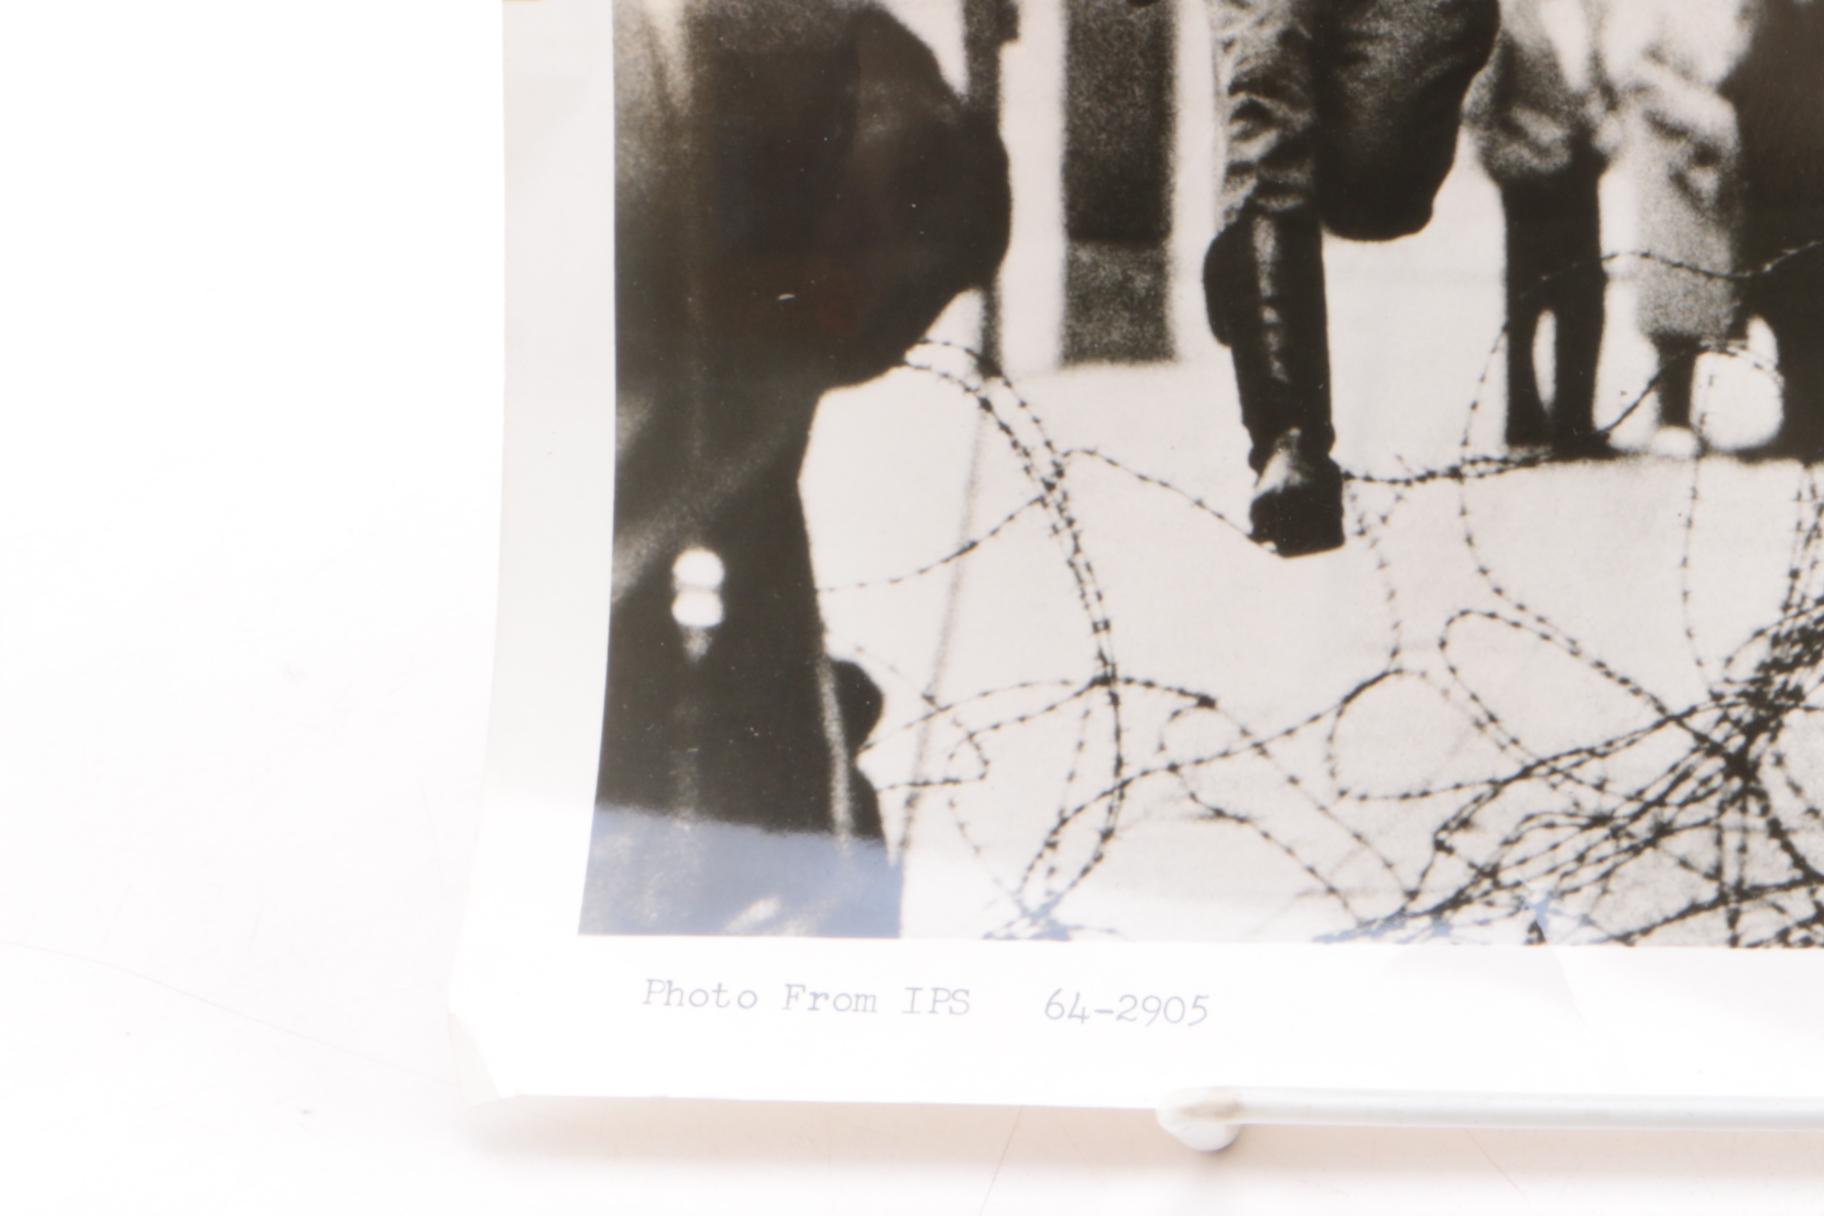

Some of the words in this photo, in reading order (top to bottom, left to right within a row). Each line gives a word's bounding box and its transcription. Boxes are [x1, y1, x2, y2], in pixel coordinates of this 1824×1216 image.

[641, 978, 759, 1012] Photo
[781, 982, 878, 1015] From
[902, 987, 972, 1017] IPS
[1042, 987, 1211, 1027] 64-2905
